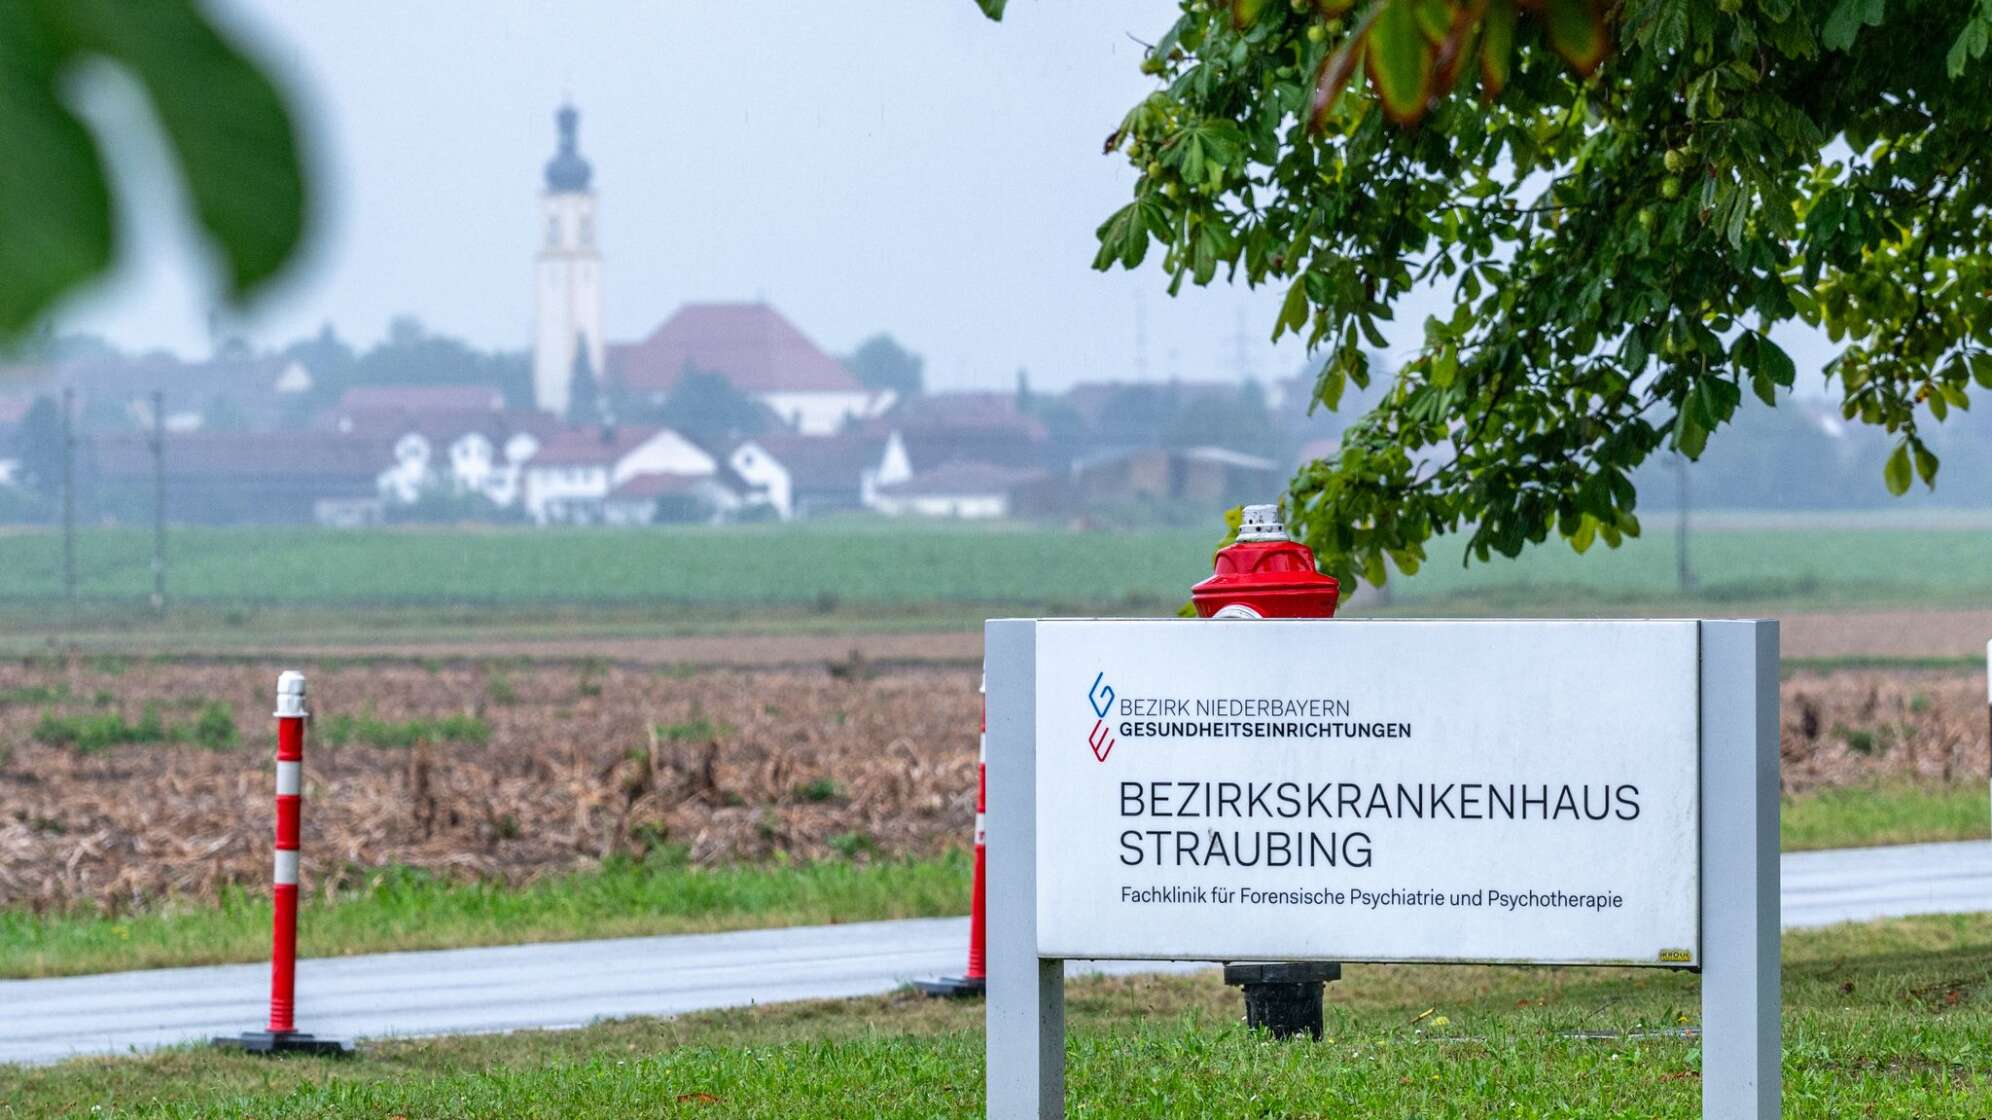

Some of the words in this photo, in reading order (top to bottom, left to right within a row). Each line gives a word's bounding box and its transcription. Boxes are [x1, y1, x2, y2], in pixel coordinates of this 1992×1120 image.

[1120, 698, 1190, 716] BEZIRK
[1196, 699, 1350, 717] NIEDERBAYERN
[1119, 721, 1412, 738] GESUNDHEITSEINRICHTUNGEN
[1120, 781, 1642, 821] BEZIRKSKRANKENHAUS
[1119, 829, 1373, 868] STRAUBING
[1121, 885, 1207, 904] Fachklinik
[1210, 886, 1236, 905] für
[1240, 886, 1346, 906] Forensische
[1349, 887, 1446, 911] Psychiatrie
[1449, 888, 1484, 907] und
[1487, 888, 1624, 913] Psychotherapie
